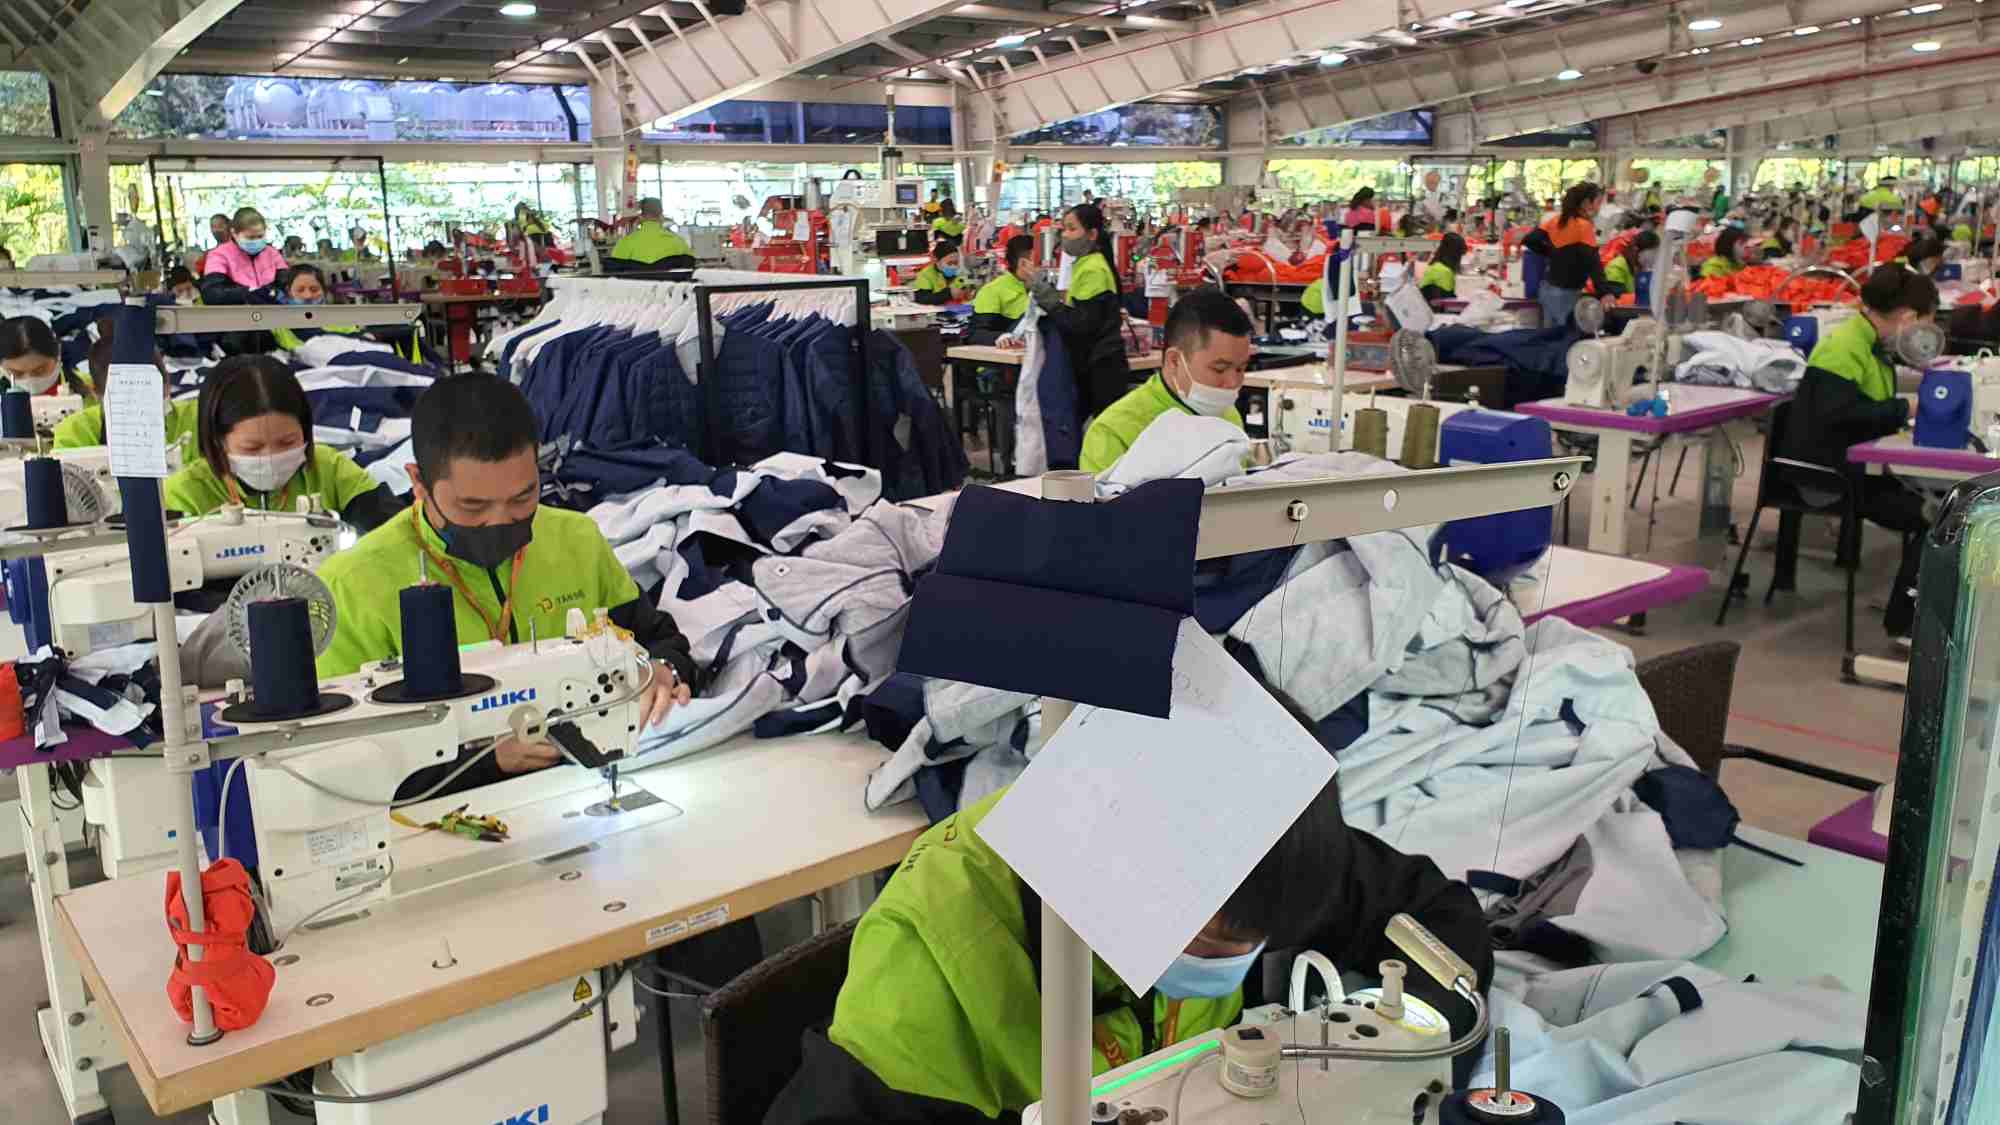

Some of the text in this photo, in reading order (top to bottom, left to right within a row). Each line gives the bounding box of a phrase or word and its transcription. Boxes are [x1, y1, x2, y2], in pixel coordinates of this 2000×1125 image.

[1308, 418, 1345, 430] JUI
[216, 545, 264, 558] JUKI
[472, 688, 536, 712] JUKI
